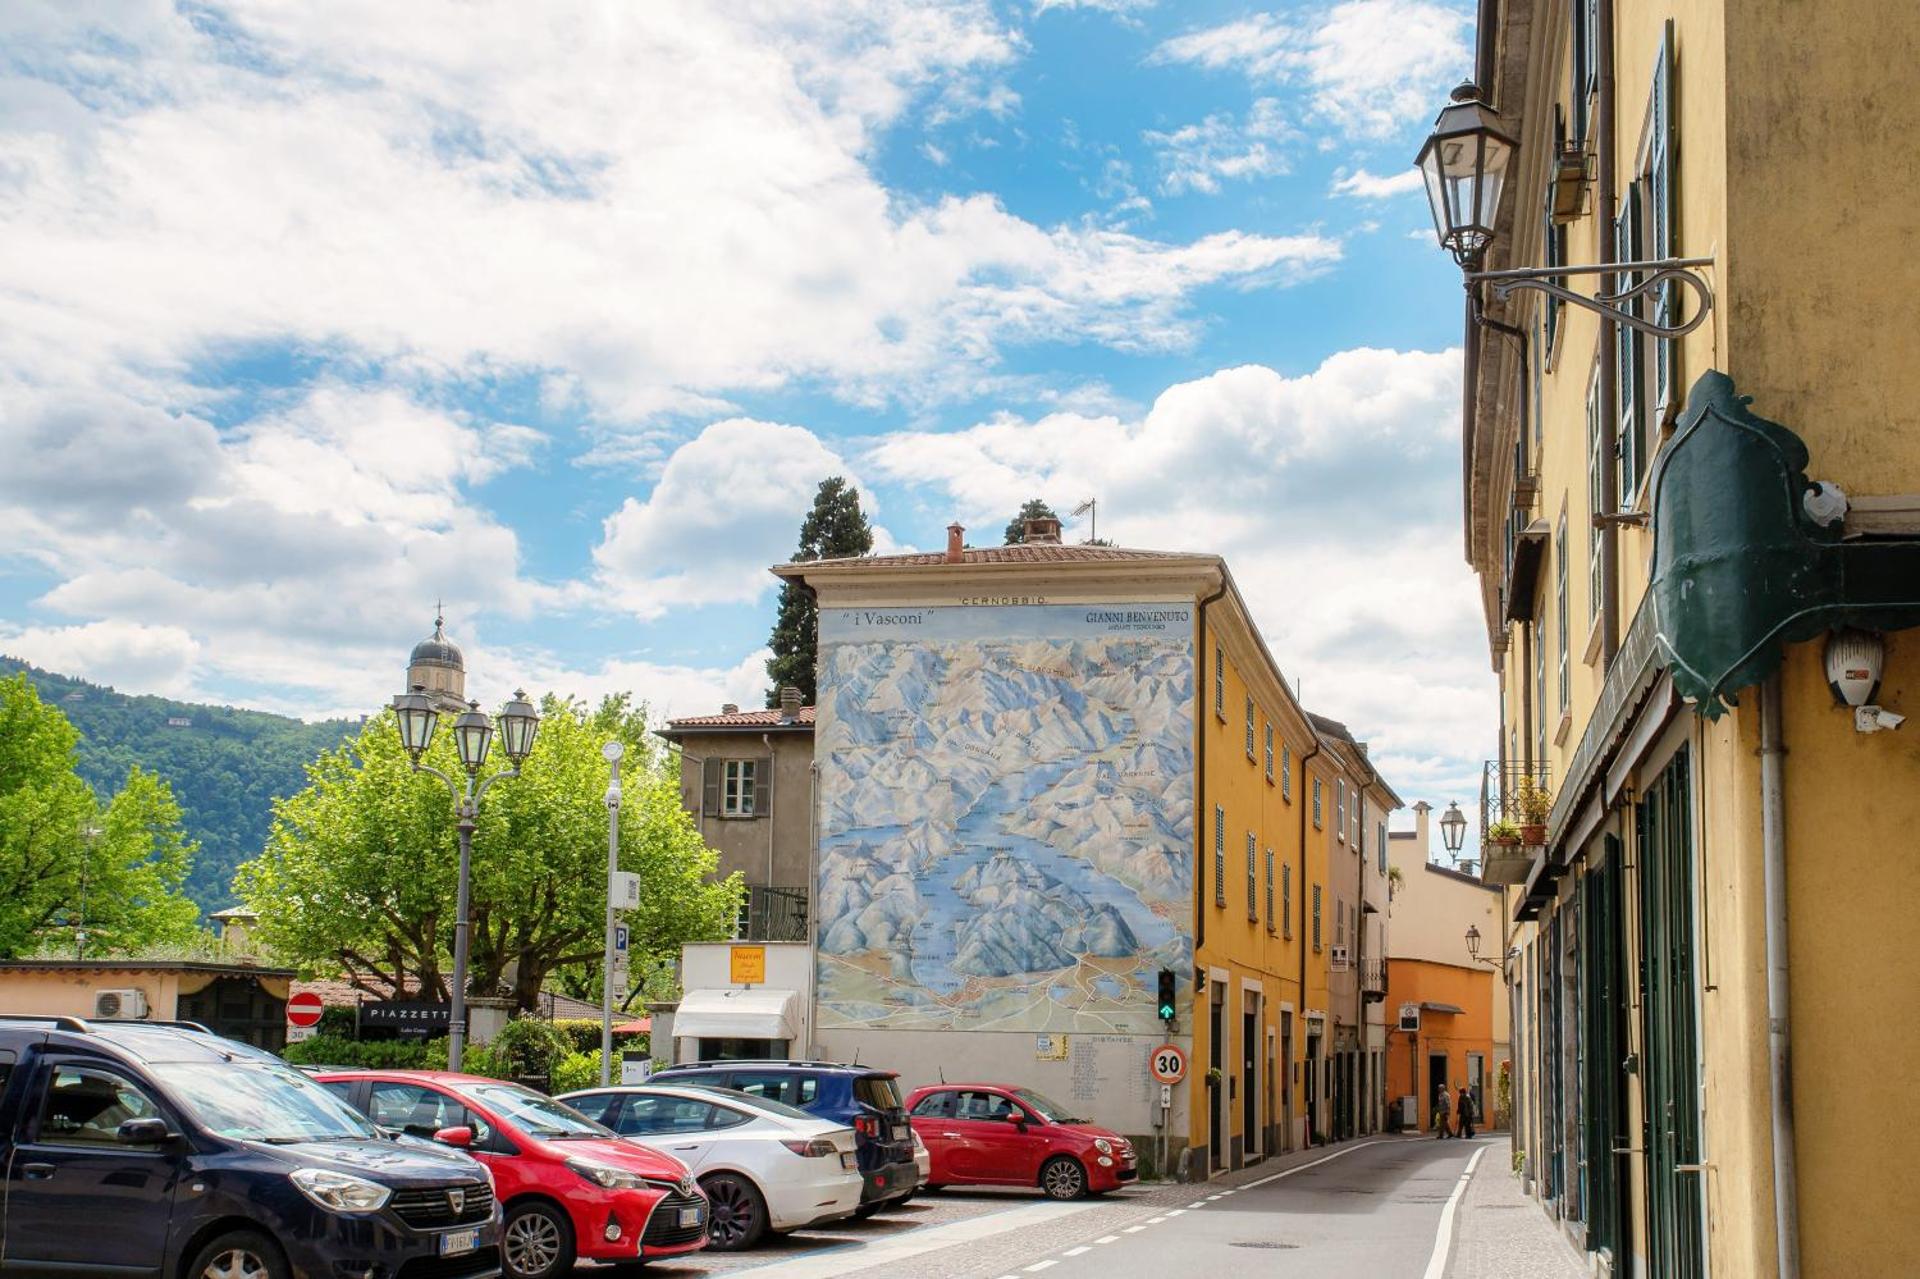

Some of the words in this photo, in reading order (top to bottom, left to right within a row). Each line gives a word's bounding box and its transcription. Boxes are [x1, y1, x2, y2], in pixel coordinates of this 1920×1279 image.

[1086, 612, 1124, 623] GIANNI
[1126, 611, 1190, 623] BENVENUTO
[370, 1009, 449, 1019] PIAZZETT
[1158, 1055, 1180, 1074] 30
